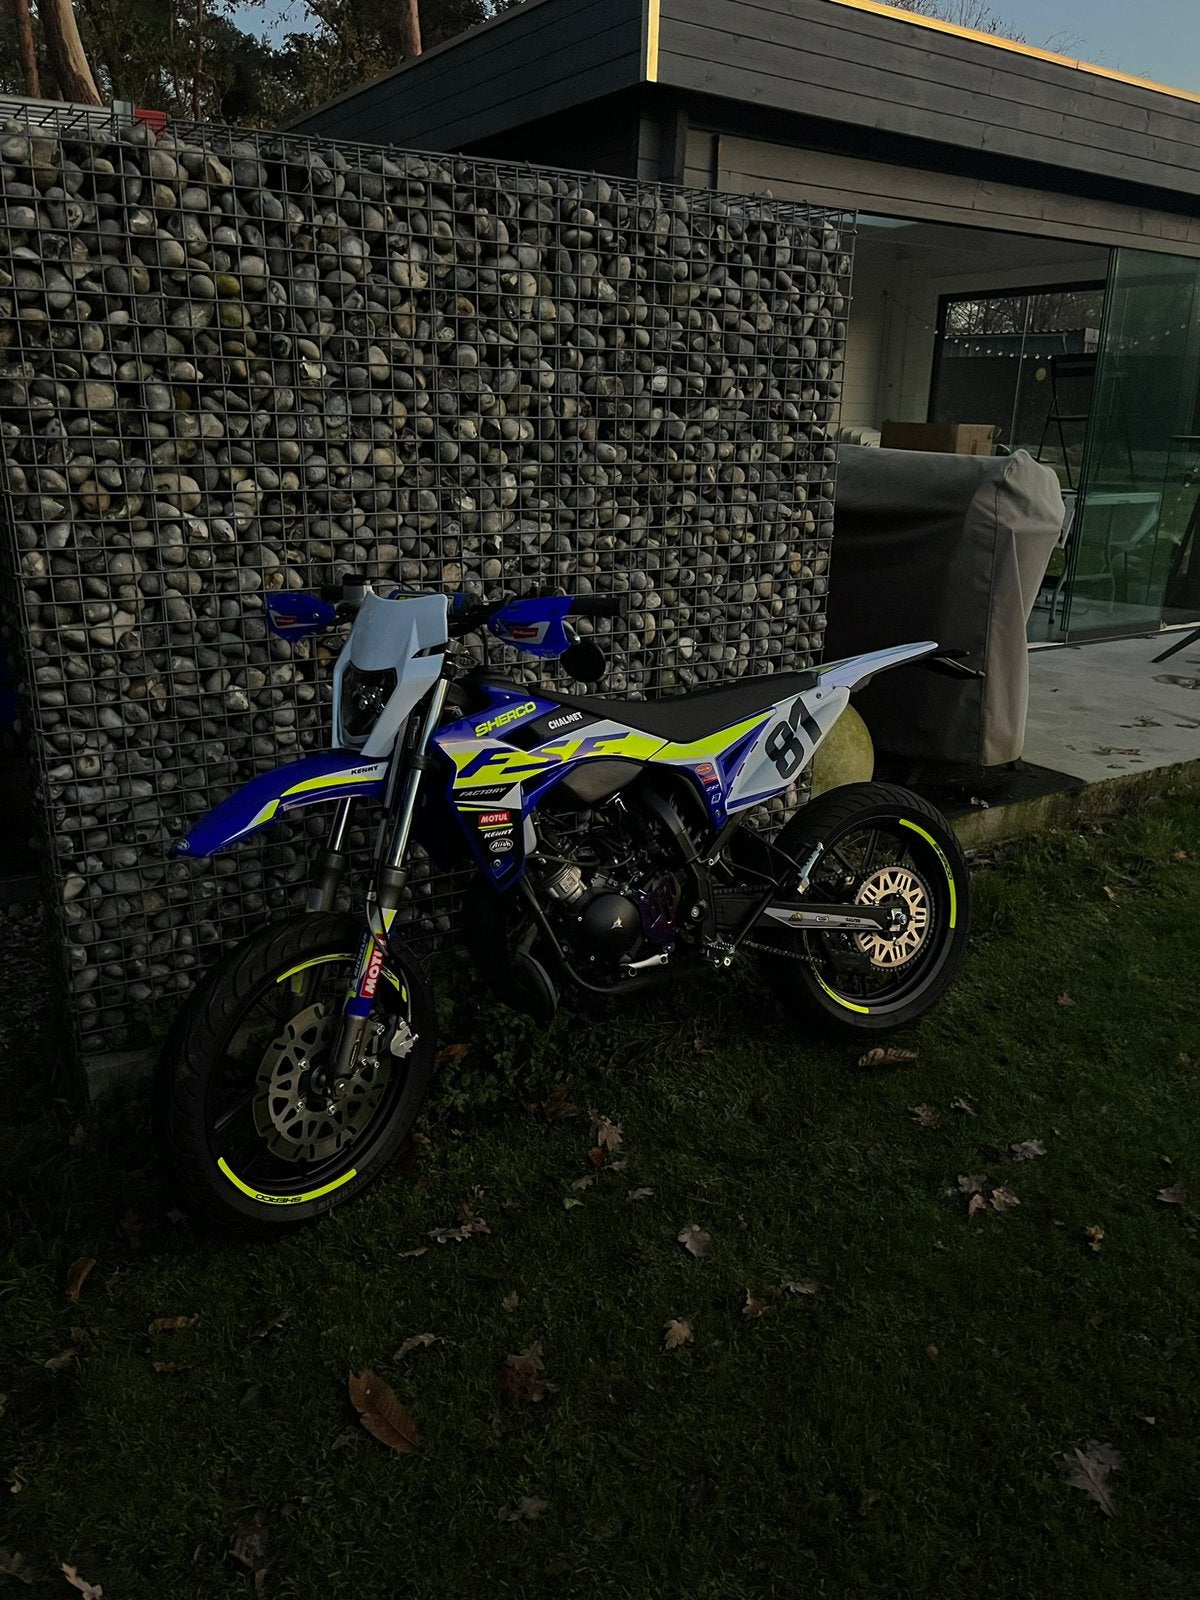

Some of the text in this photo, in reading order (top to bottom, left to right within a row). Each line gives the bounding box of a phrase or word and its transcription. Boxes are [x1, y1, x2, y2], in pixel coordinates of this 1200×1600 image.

[474, 701, 537, 738] SHERCO
[765, 696, 823, 780] 81
[351, 765, 379, 775] KENNY
[459, 786, 508, 798] FACTORY
[480, 813, 509, 824] MOTUL
[483, 828, 514, 839] KENNY
[255, 1193, 303, 1204] SHERCO
